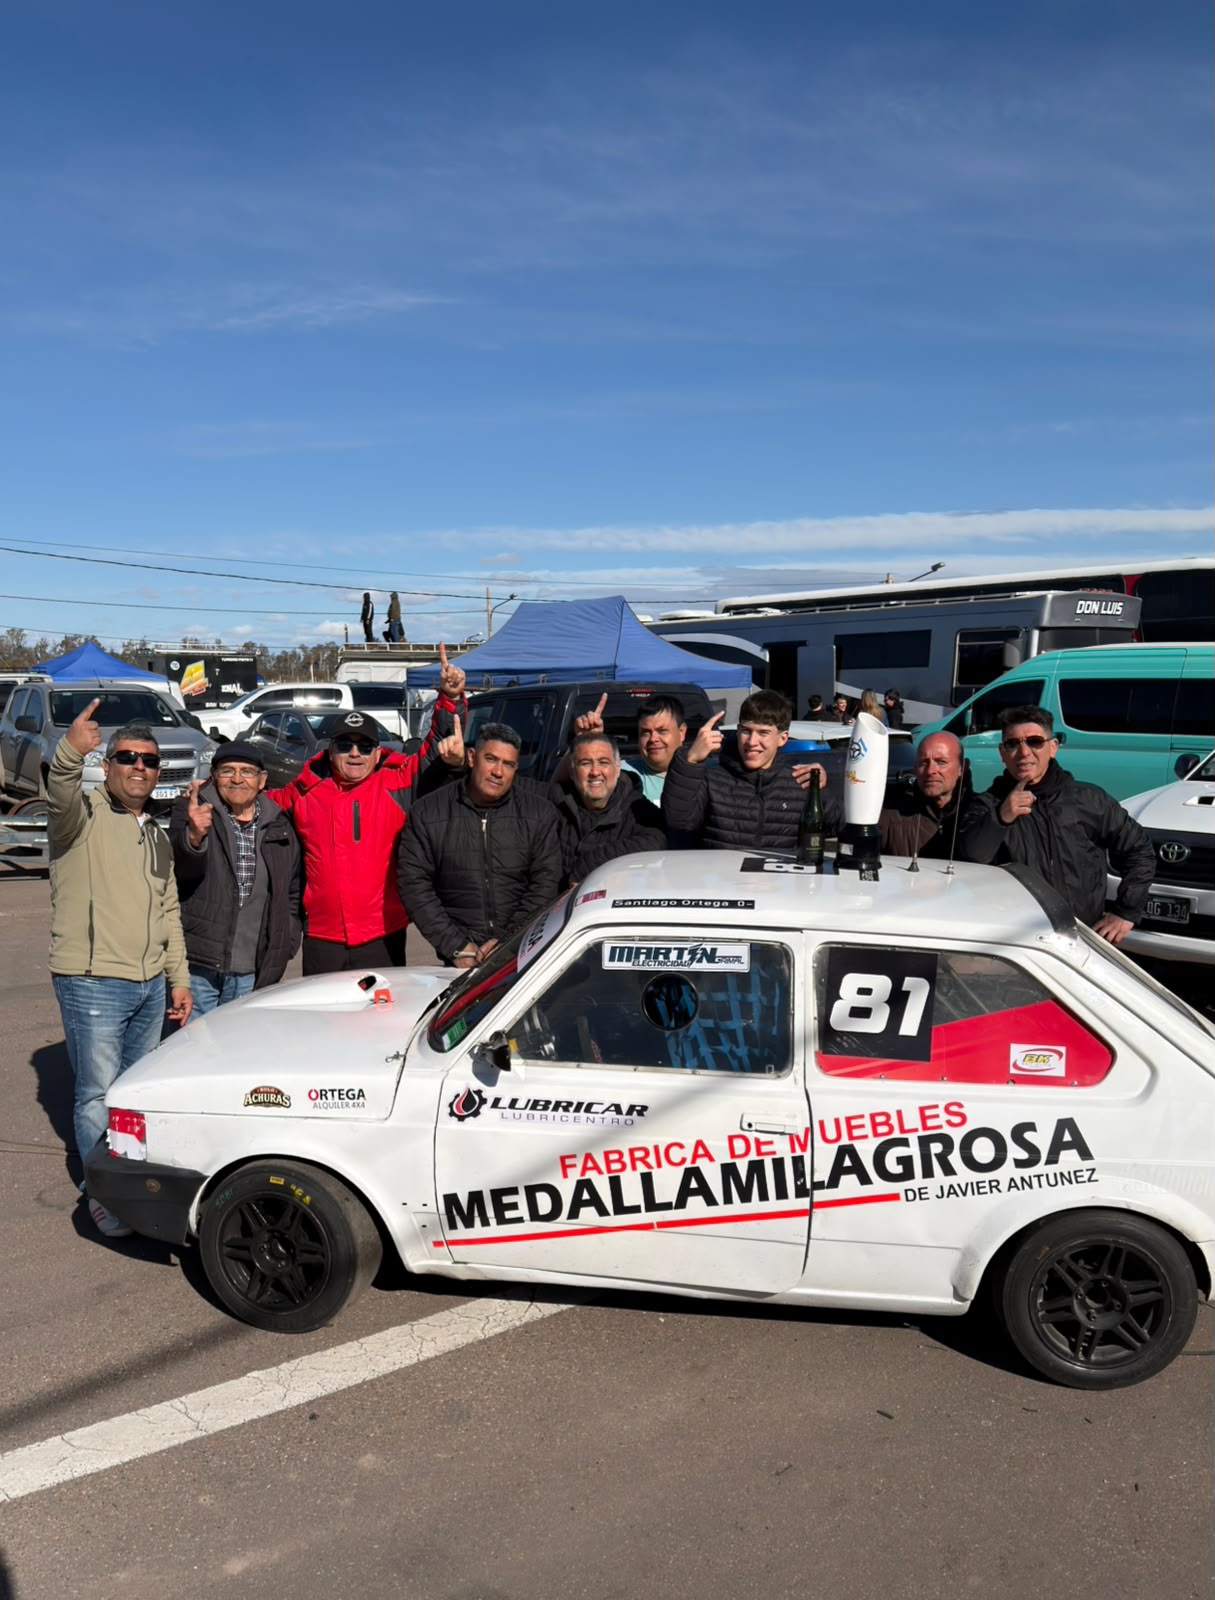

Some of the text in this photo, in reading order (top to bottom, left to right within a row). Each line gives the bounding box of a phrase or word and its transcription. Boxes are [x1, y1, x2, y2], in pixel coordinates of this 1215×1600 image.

[1076, 600, 1123, 615] DON LUIS
[681, 900, 729, 908] Ortega
[829, 972, 930, 1037] 81
[243, 1092, 292, 1108] ACHURAS
[307, 1088, 367, 1102] ORTEGA
[313, 1101, 351, 1110] ALQUILER
[489, 1097, 649, 1118] LUBRICAR
[500, 1112, 635, 1126] LUBRICENTRO
[559, 1139, 716, 1179] FABRICA
[727, 1132, 777, 1160] DE
[904, 1167, 1100, 1203] DE JAVIER ANTUNEZ
